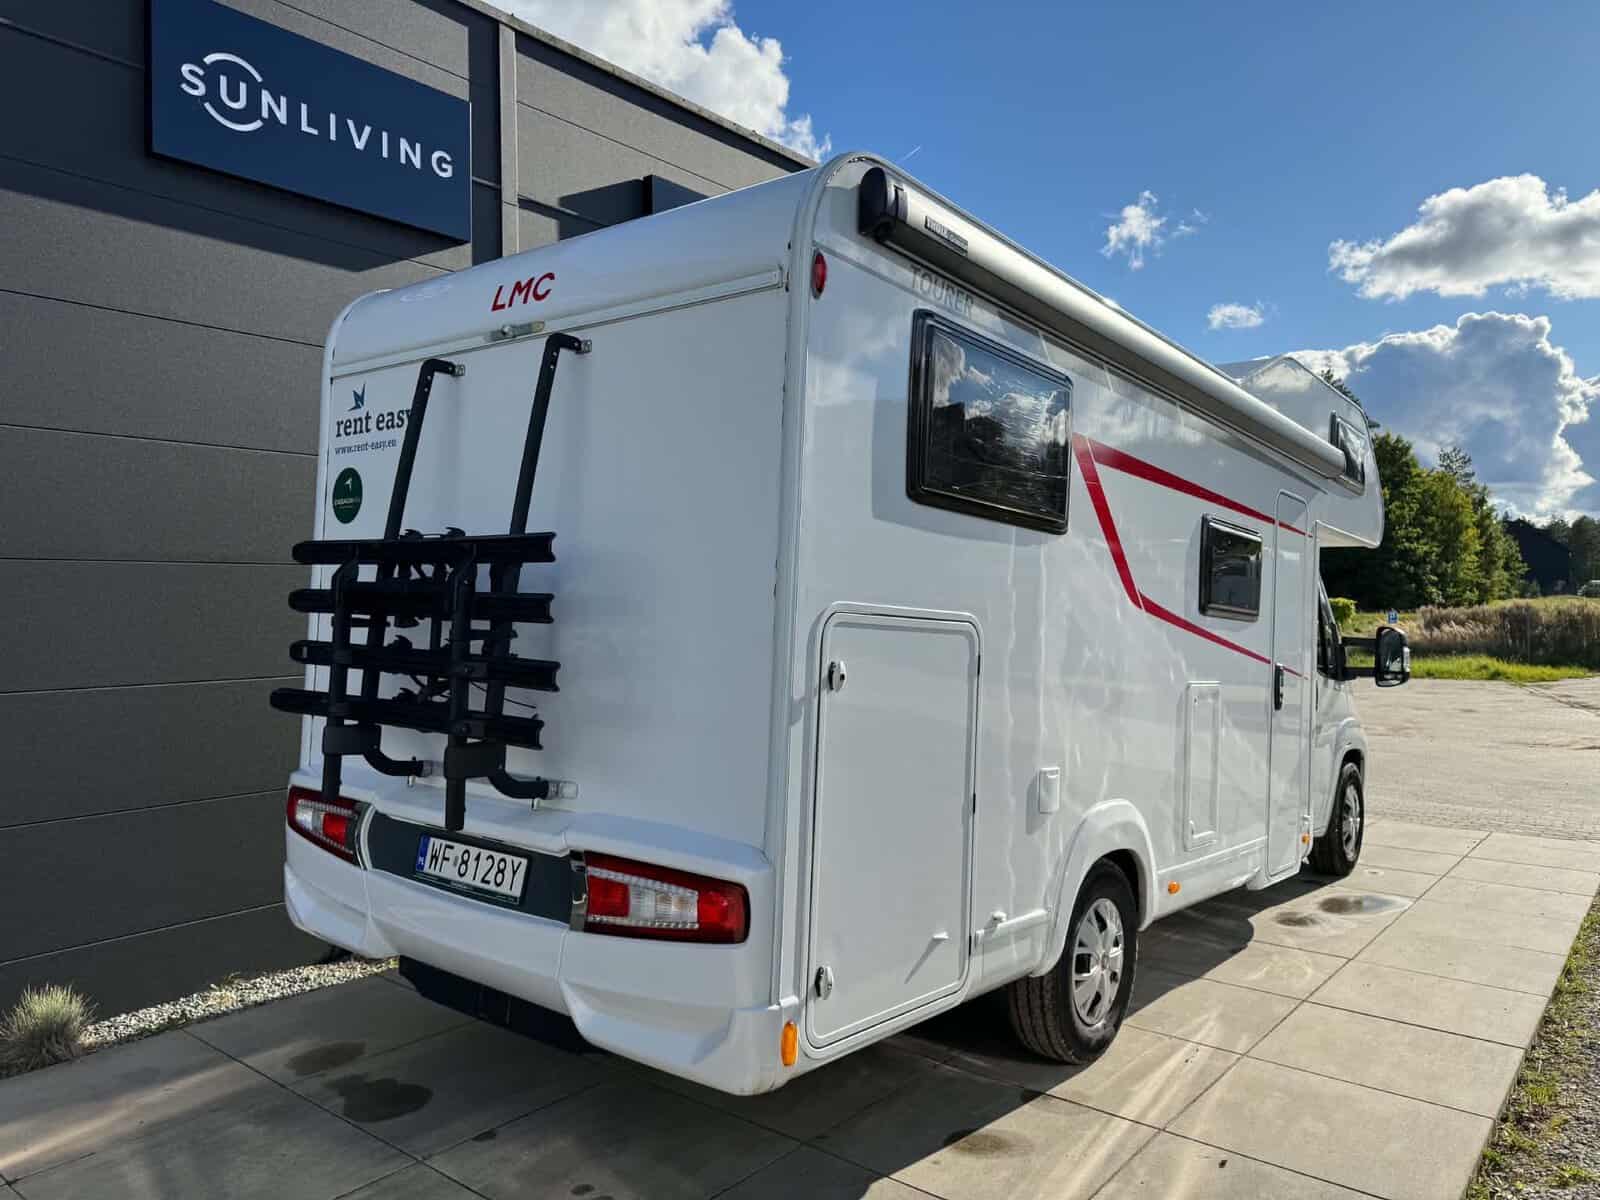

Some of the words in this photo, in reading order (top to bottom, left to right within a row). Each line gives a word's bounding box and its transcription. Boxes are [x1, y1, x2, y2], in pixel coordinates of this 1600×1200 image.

[180, 62, 453, 178] SUNLIVING
[491, 272, 555, 312] LMC
[910, 264, 974, 319] TOURER
[335, 410, 371, 438] rent
[335, 438, 397, 455] www.rent-easy.eu
[428, 840, 454, 873] WF
[457, 849, 522, 891] 8128Y
